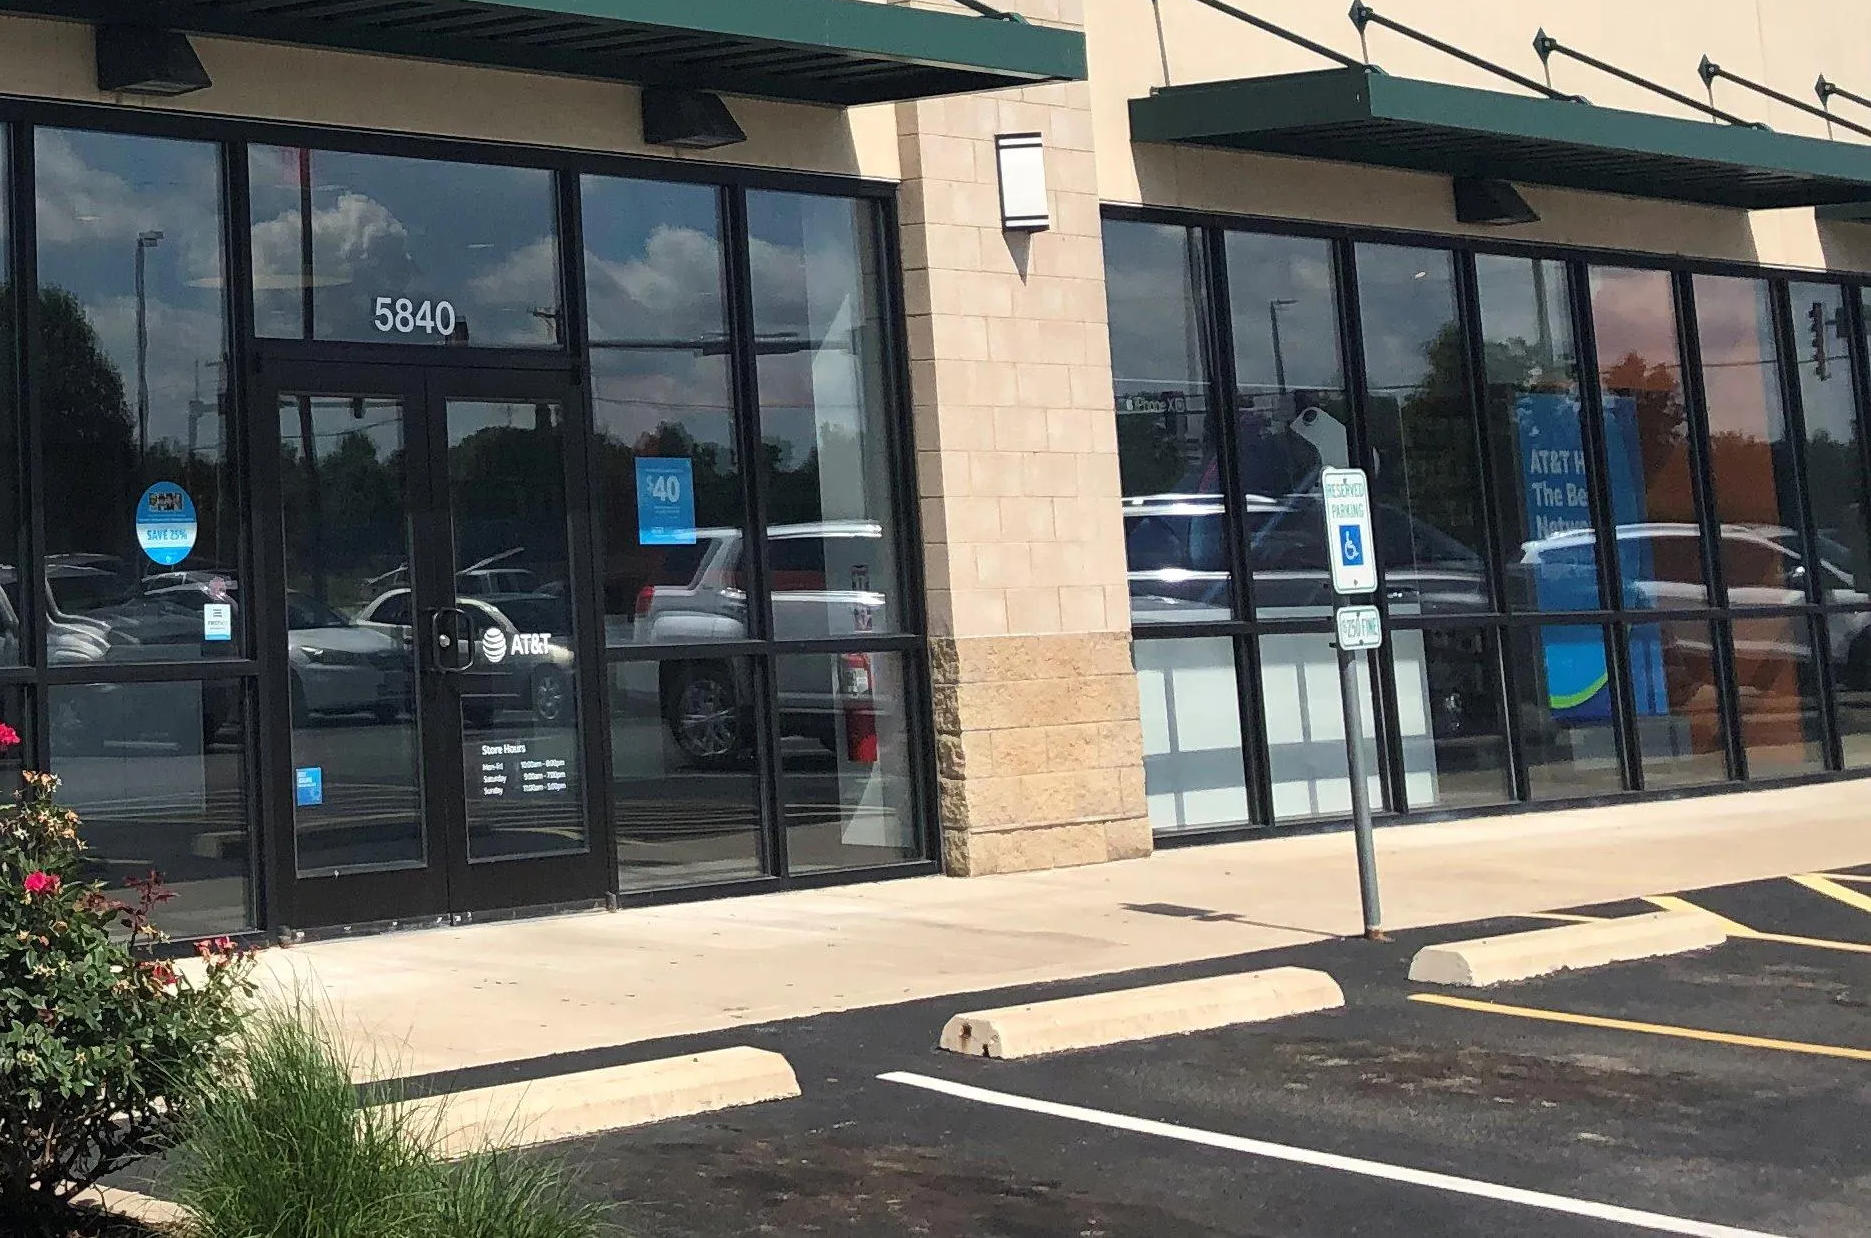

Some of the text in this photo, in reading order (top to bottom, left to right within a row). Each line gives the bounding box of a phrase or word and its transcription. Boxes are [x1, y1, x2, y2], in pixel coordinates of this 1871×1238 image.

[374, 296, 455, 336] 5840
[1530, 449, 1570, 475] AT&T
[646, 475, 681, 503] $40
[1326, 483, 1364, 499] RESERVED
[1531, 480, 1564, 507] The
[1331, 503, 1364, 519] PARKING
[510, 633, 552, 655] AT&T
[482, 744, 527, 756] Store Hours
